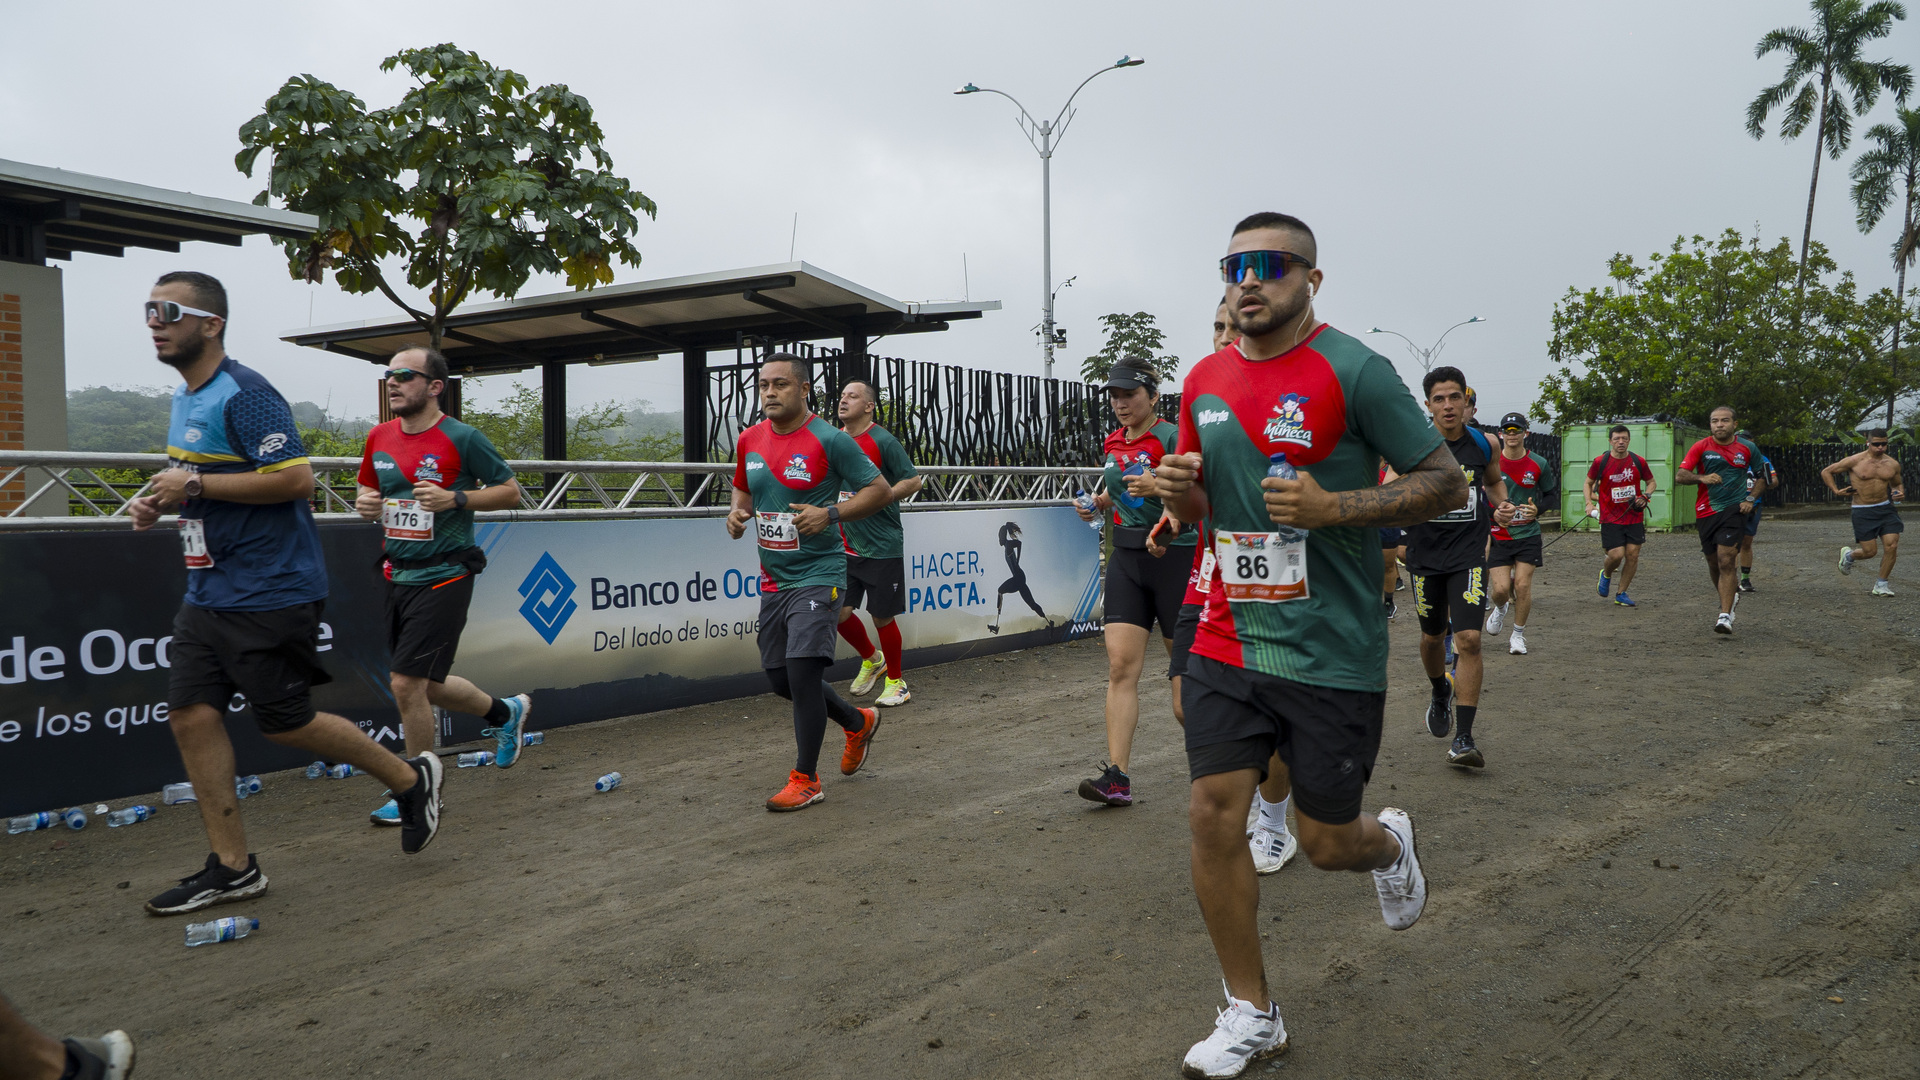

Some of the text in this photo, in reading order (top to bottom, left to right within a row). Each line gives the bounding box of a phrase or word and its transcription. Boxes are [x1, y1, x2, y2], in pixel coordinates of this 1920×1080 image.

[394, 512, 418, 527] 176
[760, 523, 784, 539] 564
[912, 550, 985, 580] HACER,
[1236, 555, 1270, 580] 86
[591, 577, 680, 611] Banco
[686, 571, 717, 603] de
[594, 627, 625, 652] Del
[632, 623, 673, 648] lado
[678, 621, 700, 641] de
[705, 618, 728, 639] los
[1070, 620, 1099, 634] AVAL
[35, 706, 92, 738] los
[104, 702, 170, 736] que
